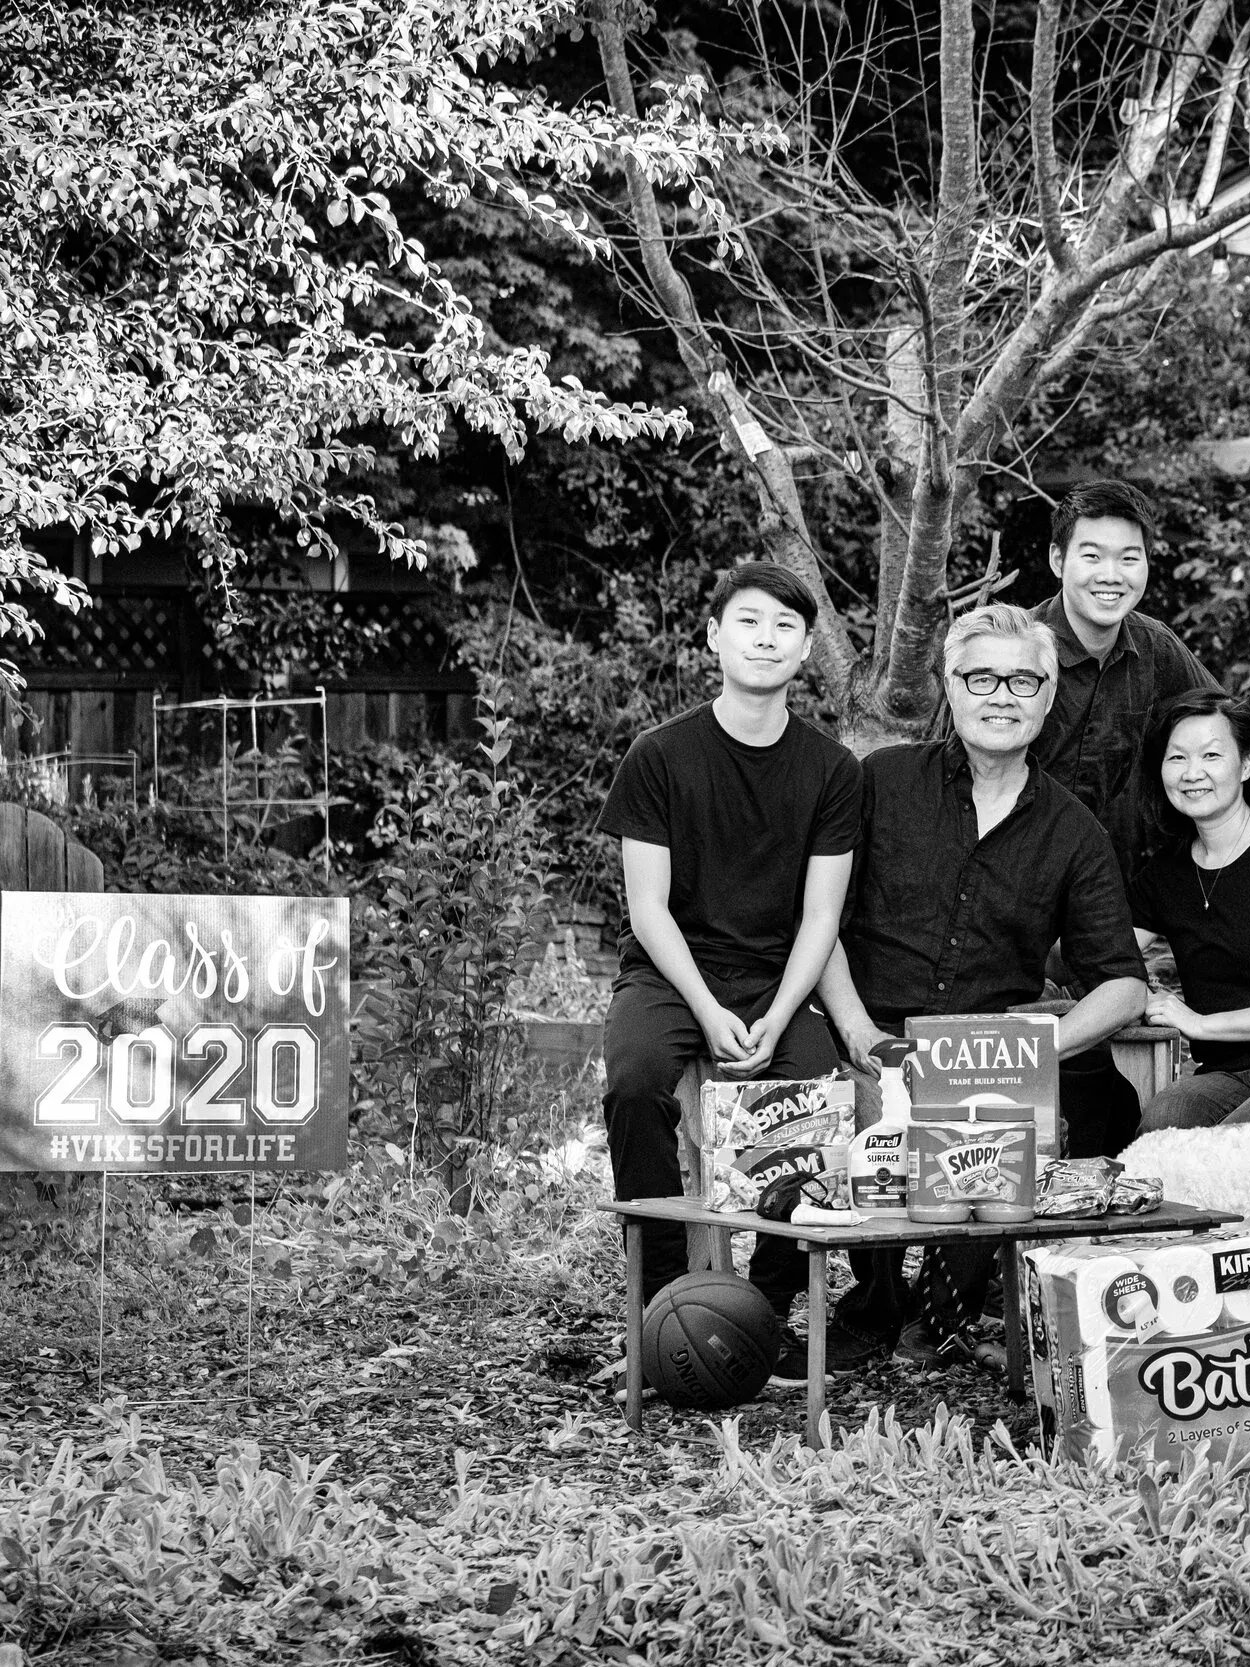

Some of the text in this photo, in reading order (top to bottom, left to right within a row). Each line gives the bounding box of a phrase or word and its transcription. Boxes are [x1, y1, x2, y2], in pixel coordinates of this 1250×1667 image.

[33, 915, 338, 1016] Class of
[930, 1037, 1041, 1071] CATAN
[34, 1021, 320, 1126] 2020
[751, 1090, 827, 1132] SPAM
[801, 1117, 829, 1131] SODIUM
[50, 1135, 296, 1162] #VIKESFORLIFE
[869, 1136, 899, 1147] Purell
[867, 1154, 900, 1162] SURFACE
[948, 1147, 1000, 1175] SKIPPY
[750, 1153, 820, 1194] SPAM
[1113, 1281, 1146, 1296] SHEETS
[1115, 1275, 1139, 1287] WIDE
[1078, 1367, 1086, 1412] KIRKLAND
[1168, 1432, 1176, 1444] 2
[1180, 1426, 1222, 1442] Layers
